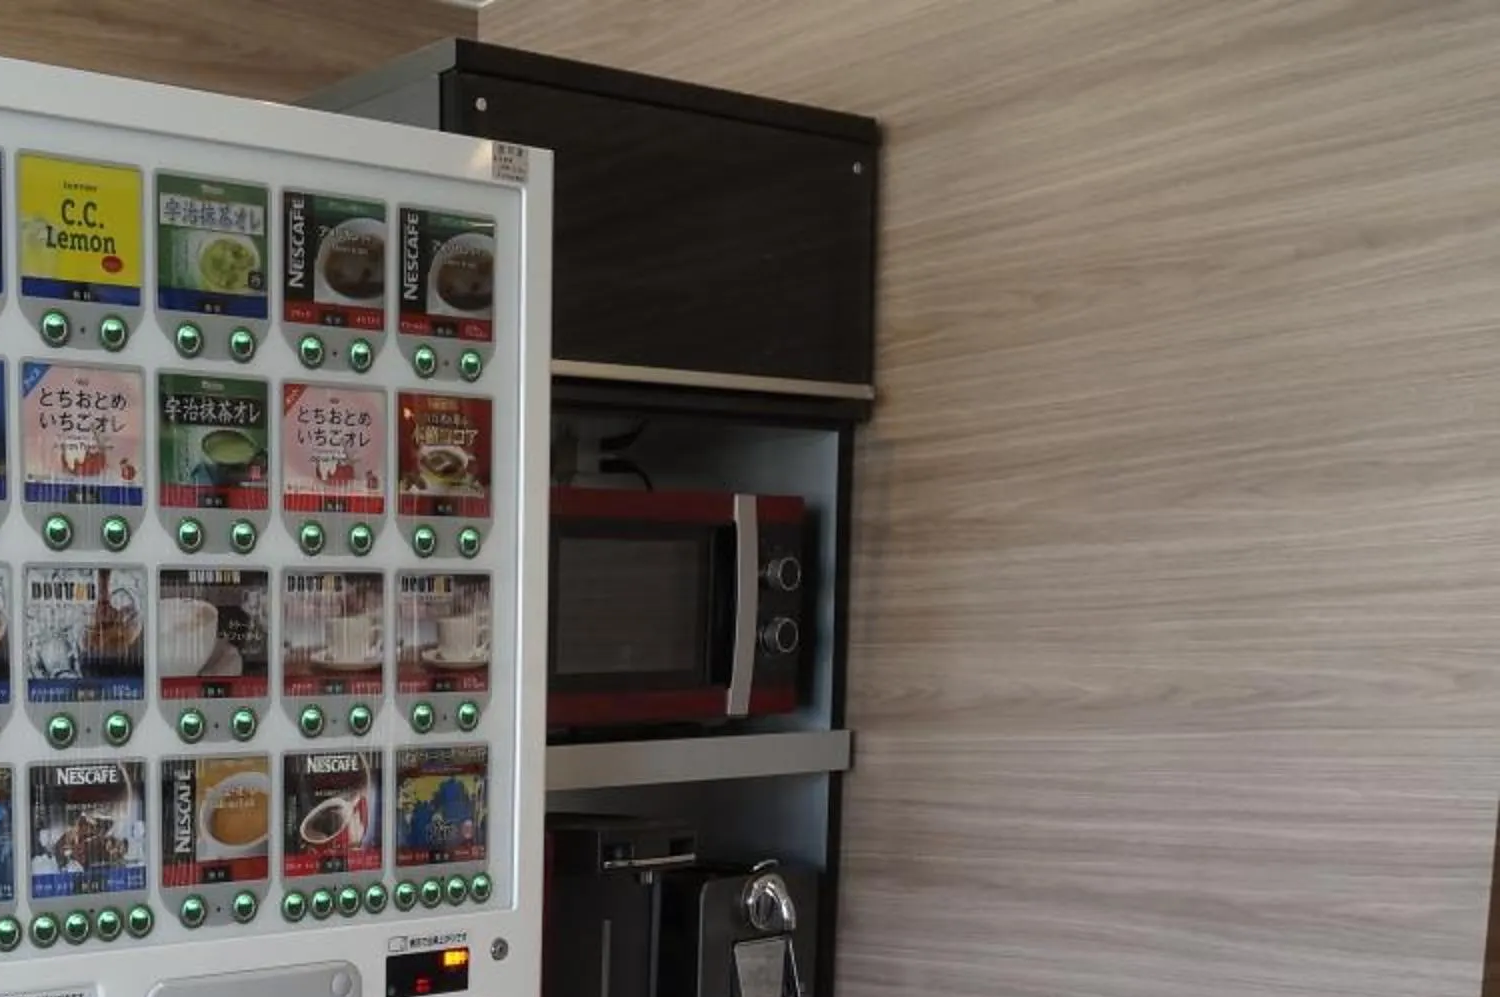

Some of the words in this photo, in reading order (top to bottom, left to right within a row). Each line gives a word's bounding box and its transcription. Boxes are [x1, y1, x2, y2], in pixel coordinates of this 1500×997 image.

[61, 199, 104, 229] C.C.
[45, 225, 116, 255] Lemon
[39, 388, 127, 411] とちおとめ
[39, 411, 125, 432] いちごオレ
[297, 407, 371, 426] とちおとめ
[297, 427, 370, 447] いちごオレ
